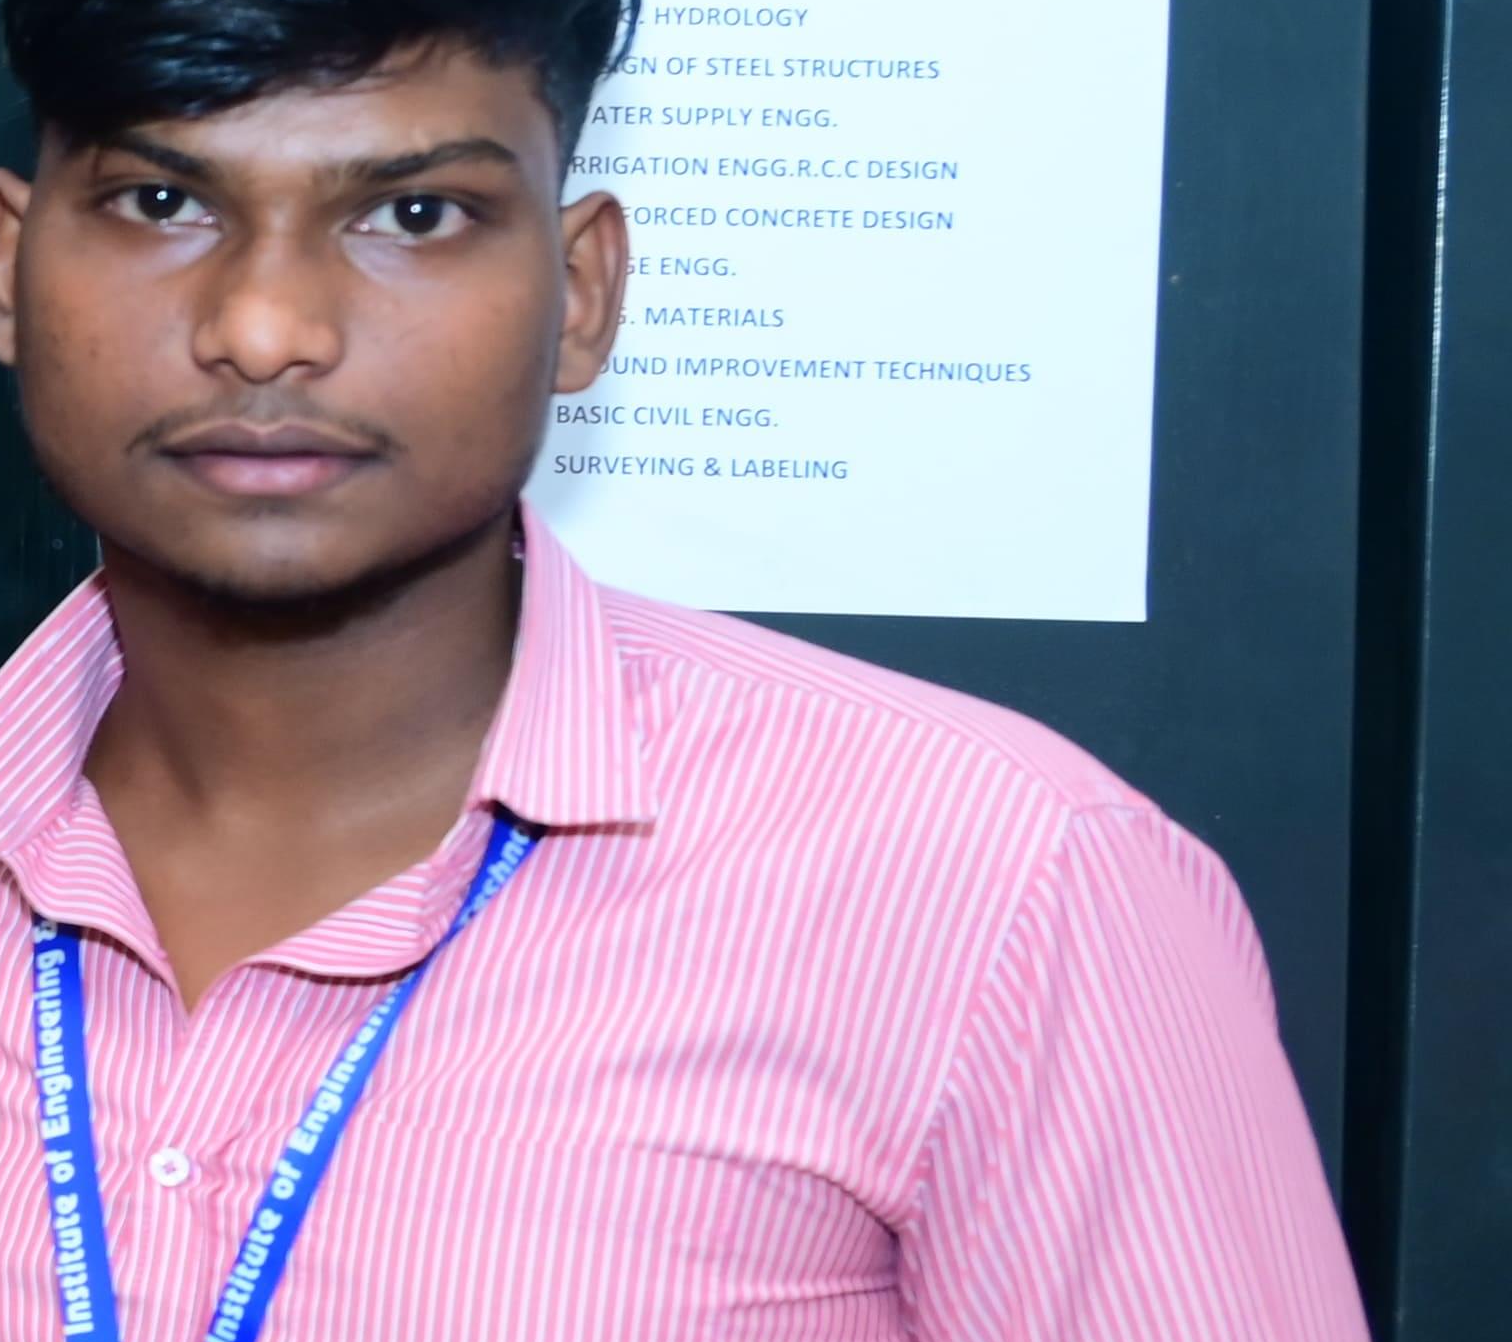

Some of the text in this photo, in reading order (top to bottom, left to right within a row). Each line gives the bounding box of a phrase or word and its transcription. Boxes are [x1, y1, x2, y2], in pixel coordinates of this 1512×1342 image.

[655, 7, 808, 27] HYDROLOGY
[666, 56, 697, 76] OF
[706, 57, 775, 77] STEEL
[783, 58, 940, 80] STRUCTURES
[588, 105, 837, 128] ATER SUPPLY ENGG.
[570, 155, 957, 180] RRIGATION ENGG.R.C.C DESIGN
[725, 207, 953, 230] CONCRETE DESIGN
[660, 257, 737, 277] ENGG.
[645, 307, 784, 328] MATERIALS
[600, 356, 1031, 384] OUND IMPROVEMENT TECHNIQUES
[556, 404, 778, 428] BASIC CIVIL ENGG.
[554, 454, 847, 480] SURVEYING & LABELING
[34, 947, 72, 1147] Engineering
[45, 1147, 76, 1183] of
[270, 1155, 303, 1201] of
[54, 1192, 95, 1336] Institute
